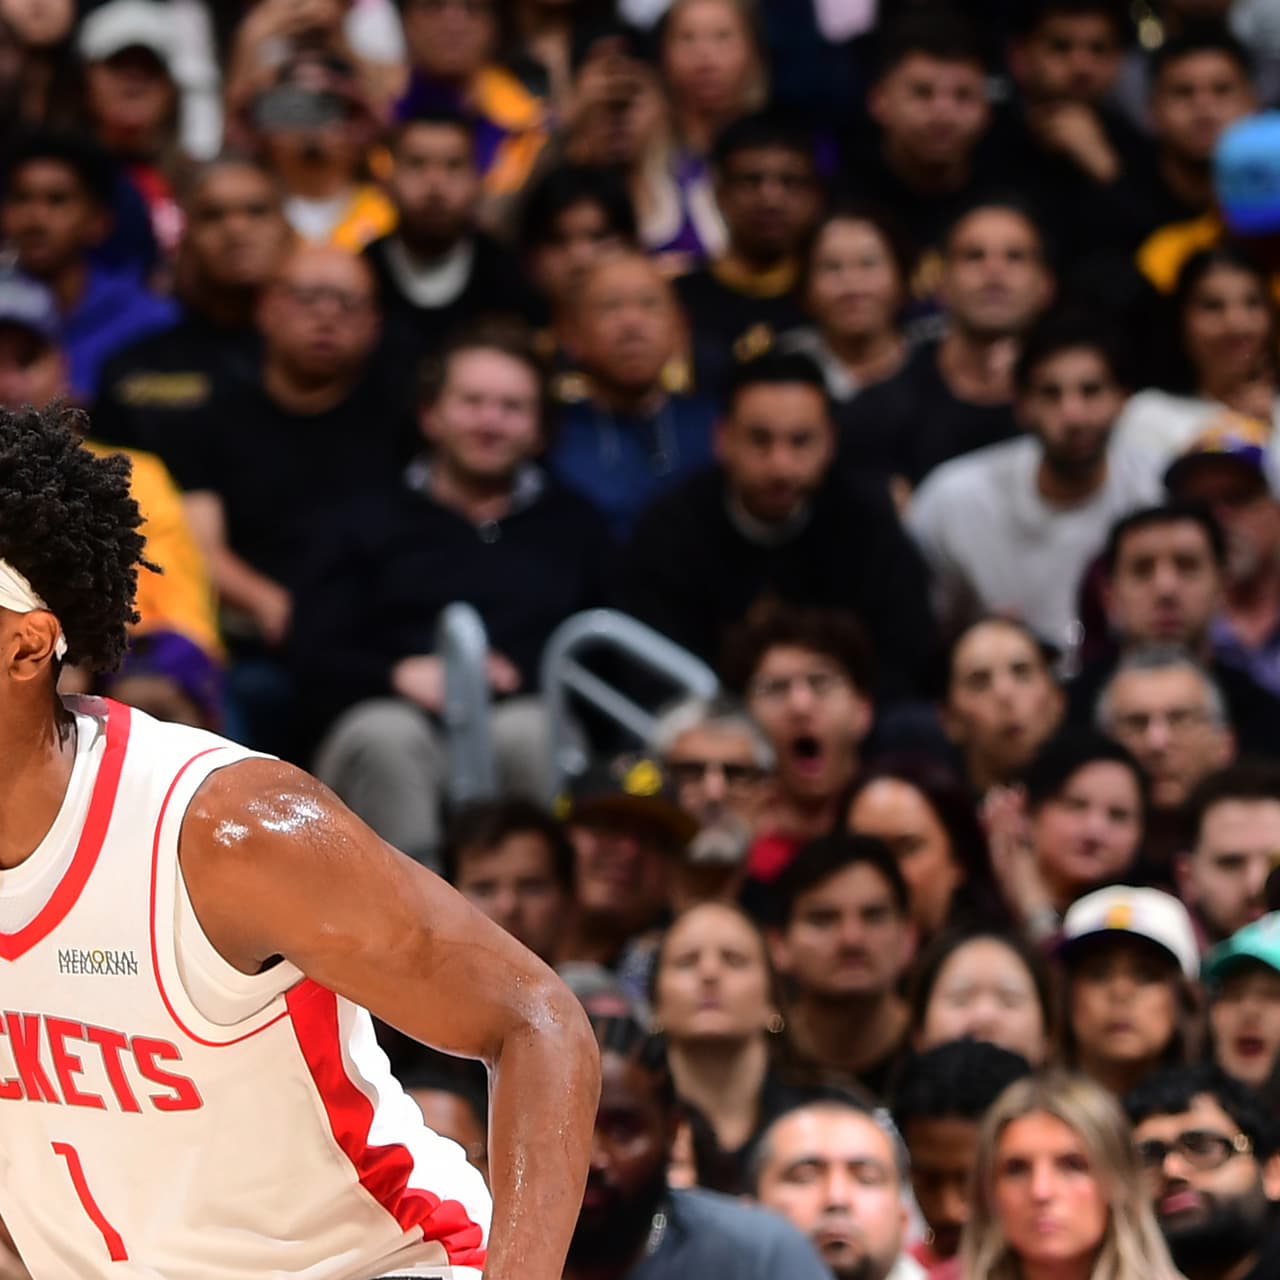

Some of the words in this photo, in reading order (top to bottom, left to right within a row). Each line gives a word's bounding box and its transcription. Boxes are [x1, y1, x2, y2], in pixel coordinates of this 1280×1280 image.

[57, 948, 137, 964] MEMORIAL
[58, 960, 138, 975] HERMANN
[50, 1141, 129, 1262] 1
